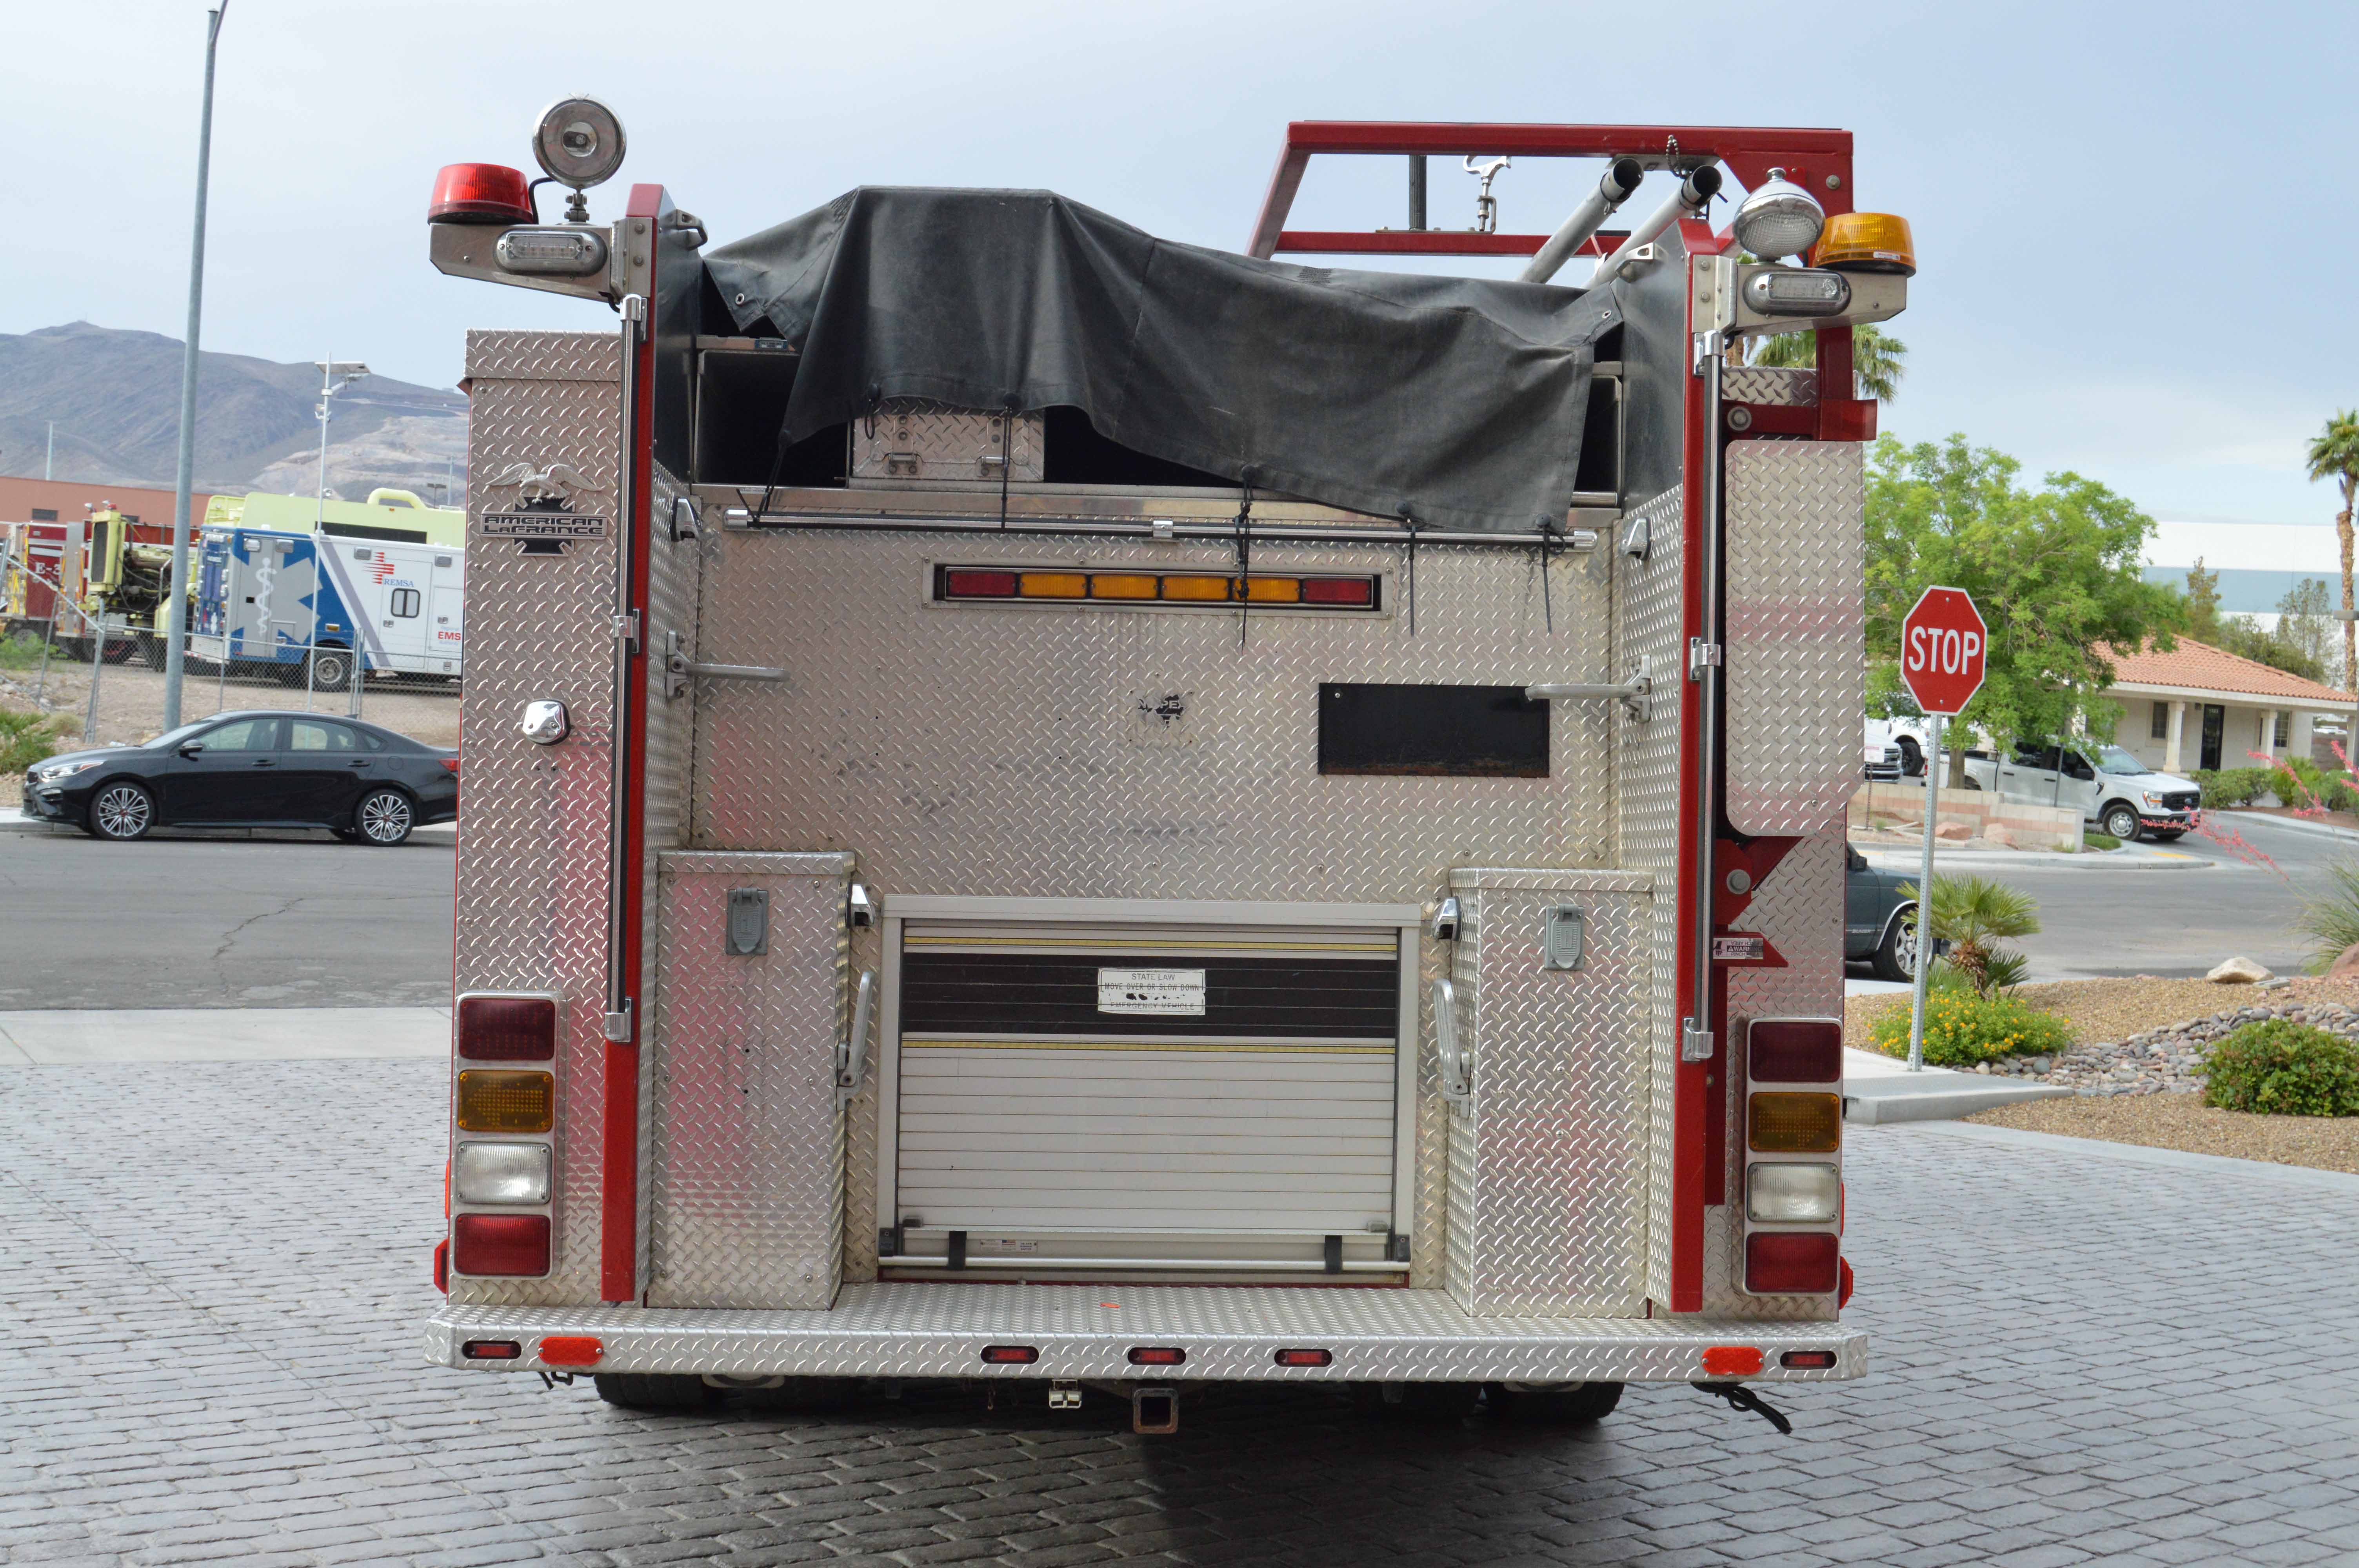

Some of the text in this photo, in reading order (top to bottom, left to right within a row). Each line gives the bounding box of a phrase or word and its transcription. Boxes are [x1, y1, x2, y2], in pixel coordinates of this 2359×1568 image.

[484, 516, 603, 526] AMERICAN
[384, 578, 414, 587] REMSA
[438, 631, 461, 640] EMS
[1908, 626, 1980, 675] STOP
[1159, 983, 1176, 991] SLOW
